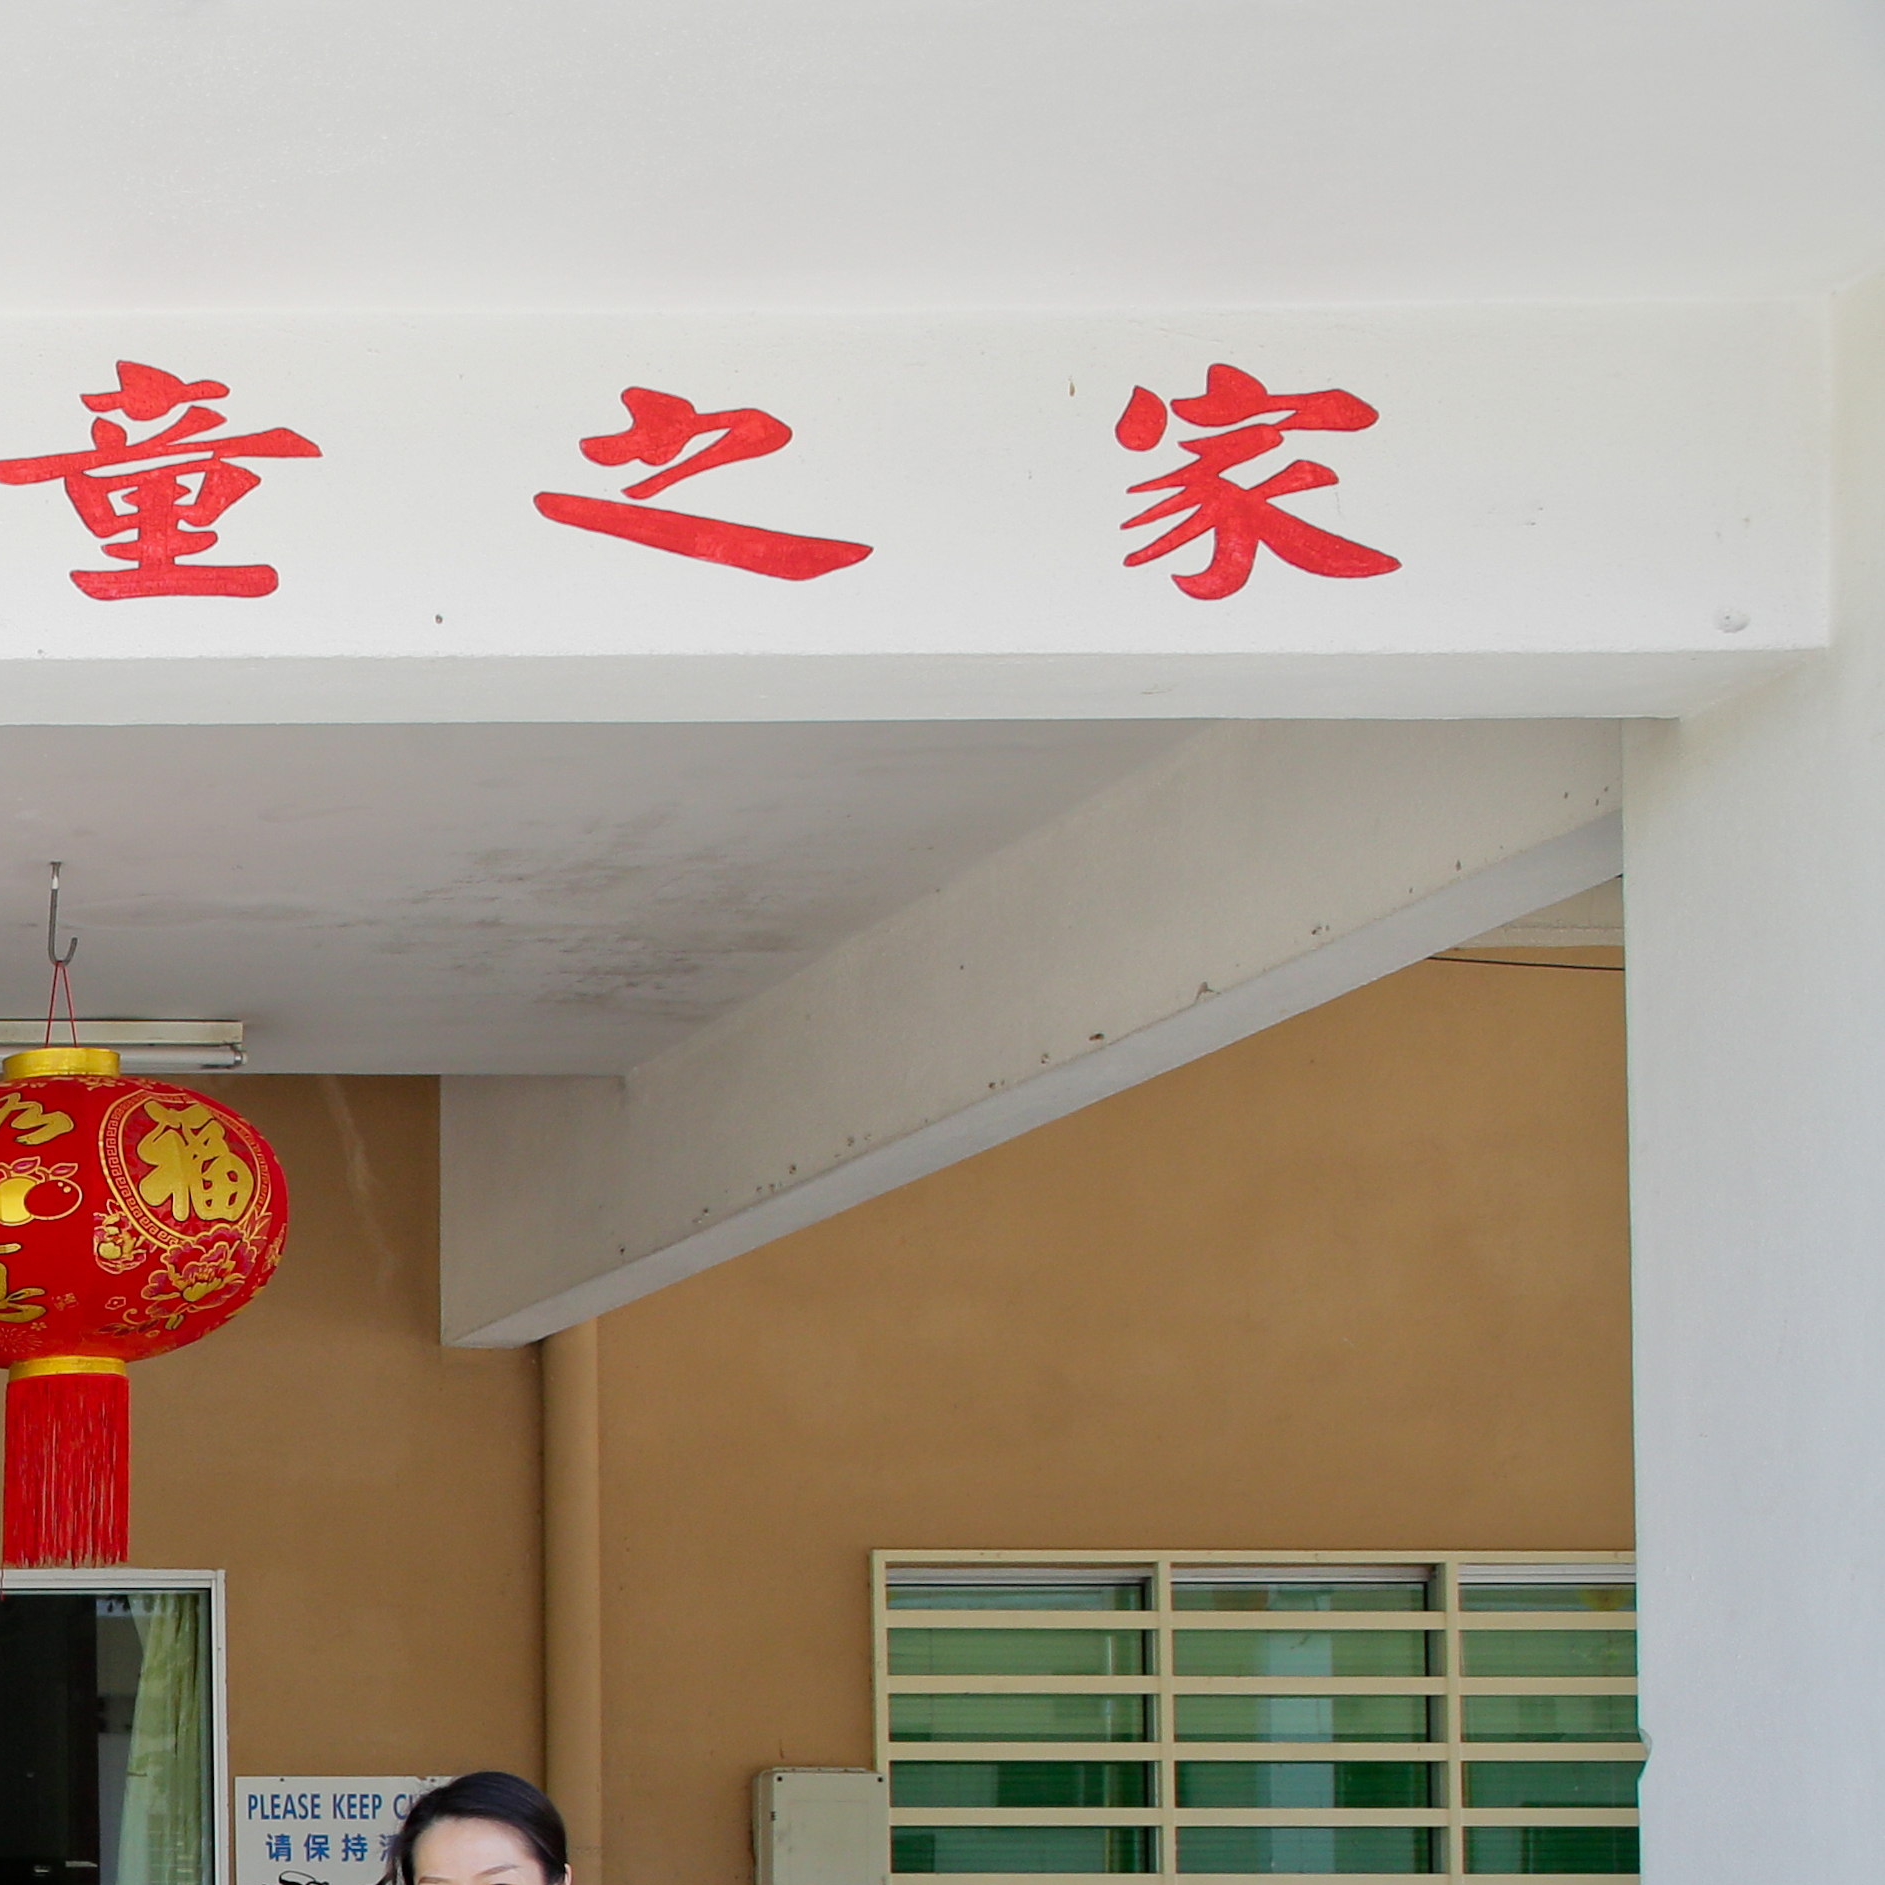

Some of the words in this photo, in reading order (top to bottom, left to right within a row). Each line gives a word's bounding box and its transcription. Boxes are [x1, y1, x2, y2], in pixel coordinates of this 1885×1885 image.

[136, 1100, 256, 1222] 福
[247, 1793, 321, 1820] PLEASE
[332, 1793, 382, 1820] KEEP
